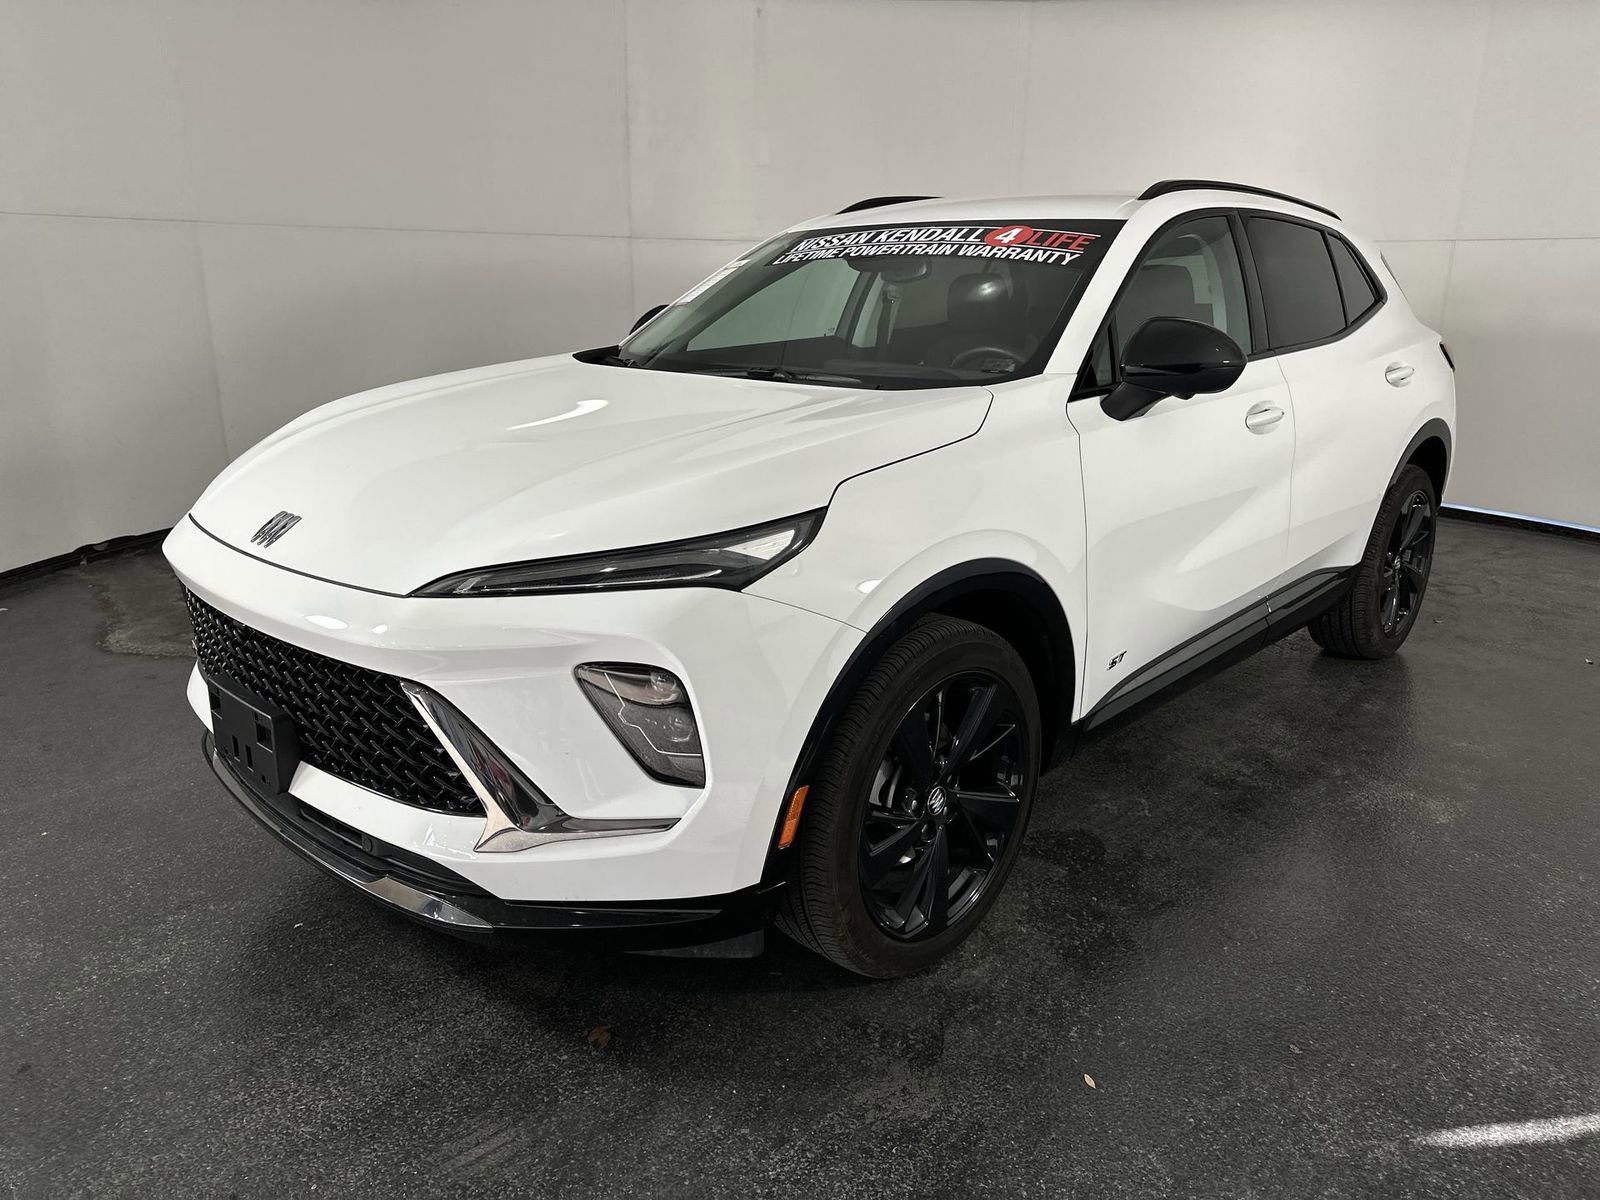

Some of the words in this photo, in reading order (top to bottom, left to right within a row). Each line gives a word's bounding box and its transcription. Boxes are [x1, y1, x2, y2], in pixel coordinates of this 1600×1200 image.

[790, 232, 874, 252] NISSAN
[871, 227, 985, 244] KENDALL
[994, 228, 1023, 244] 4
[1024, 231, 1096, 251] LIFE
[772, 247, 842, 265] LIFETIME
[838, 243, 955, 258] POWERTRAIN
[957, 244, 1081, 266] WARRANTY
